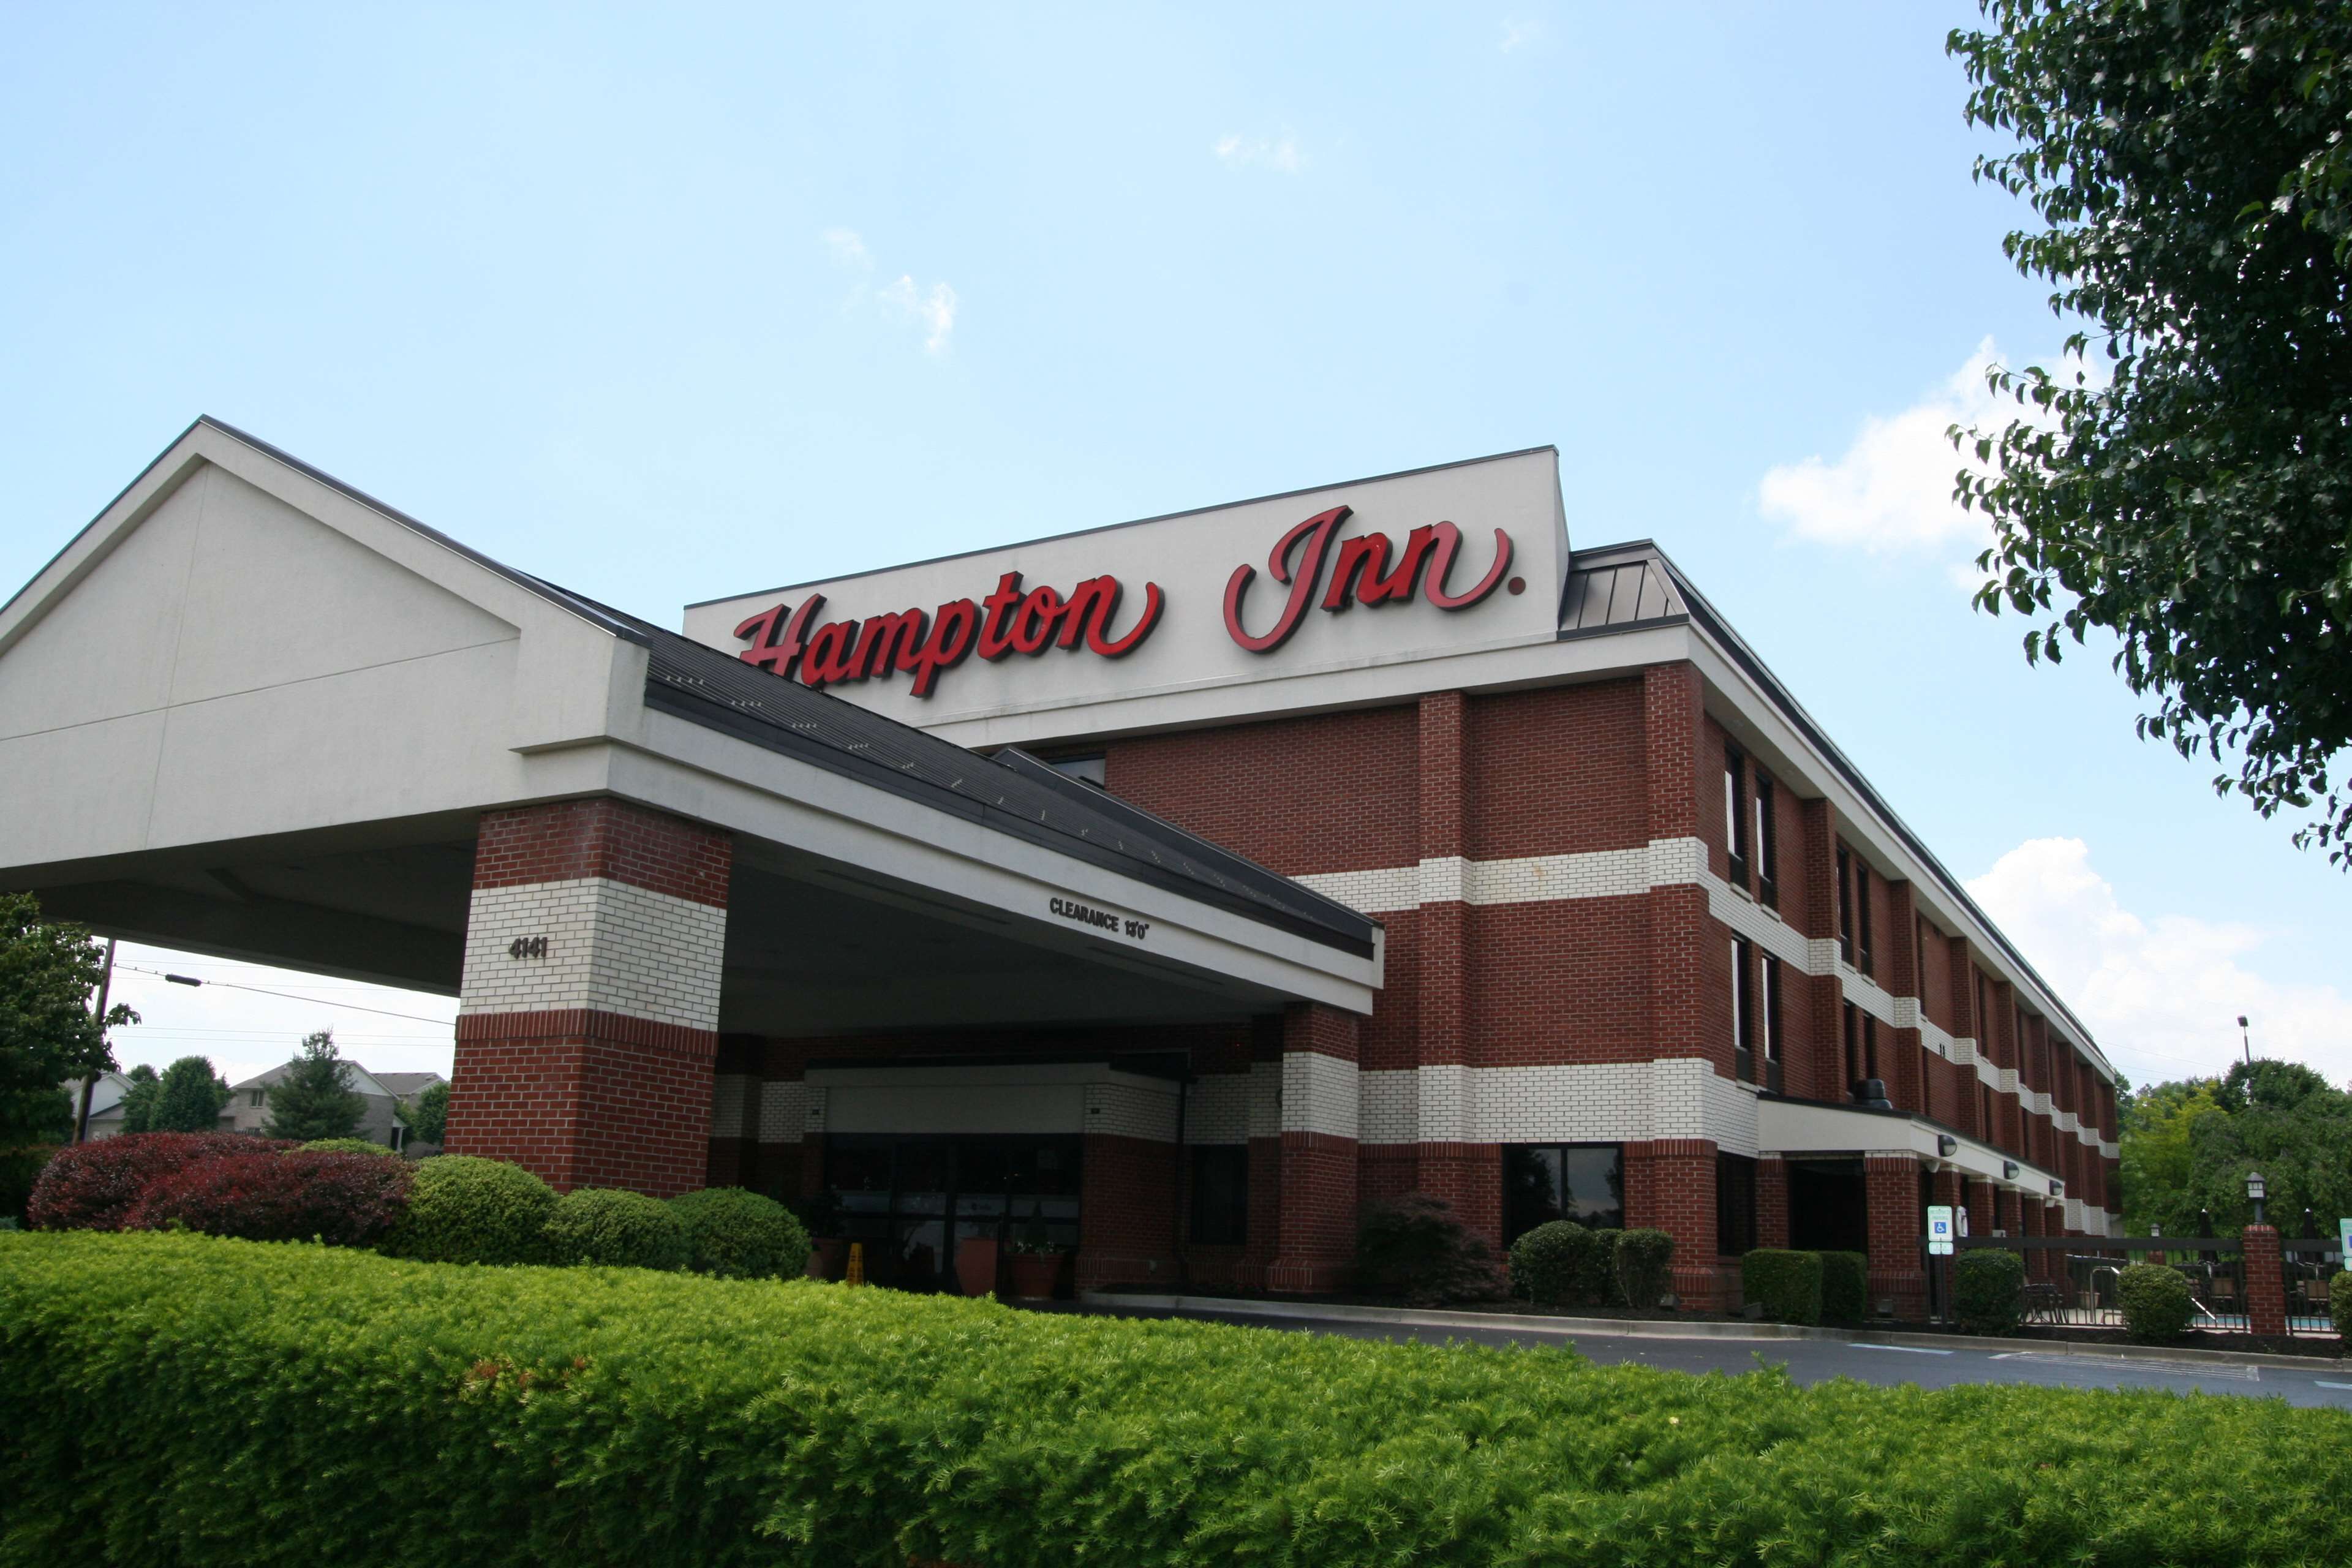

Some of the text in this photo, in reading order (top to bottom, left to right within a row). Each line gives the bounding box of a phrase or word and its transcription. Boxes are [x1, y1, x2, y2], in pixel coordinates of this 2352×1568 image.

[733, 570, 1165, 699] Hampton
[1049, 897, 1119, 932] CLEARANCE
[508, 936, 548, 960] 4141
